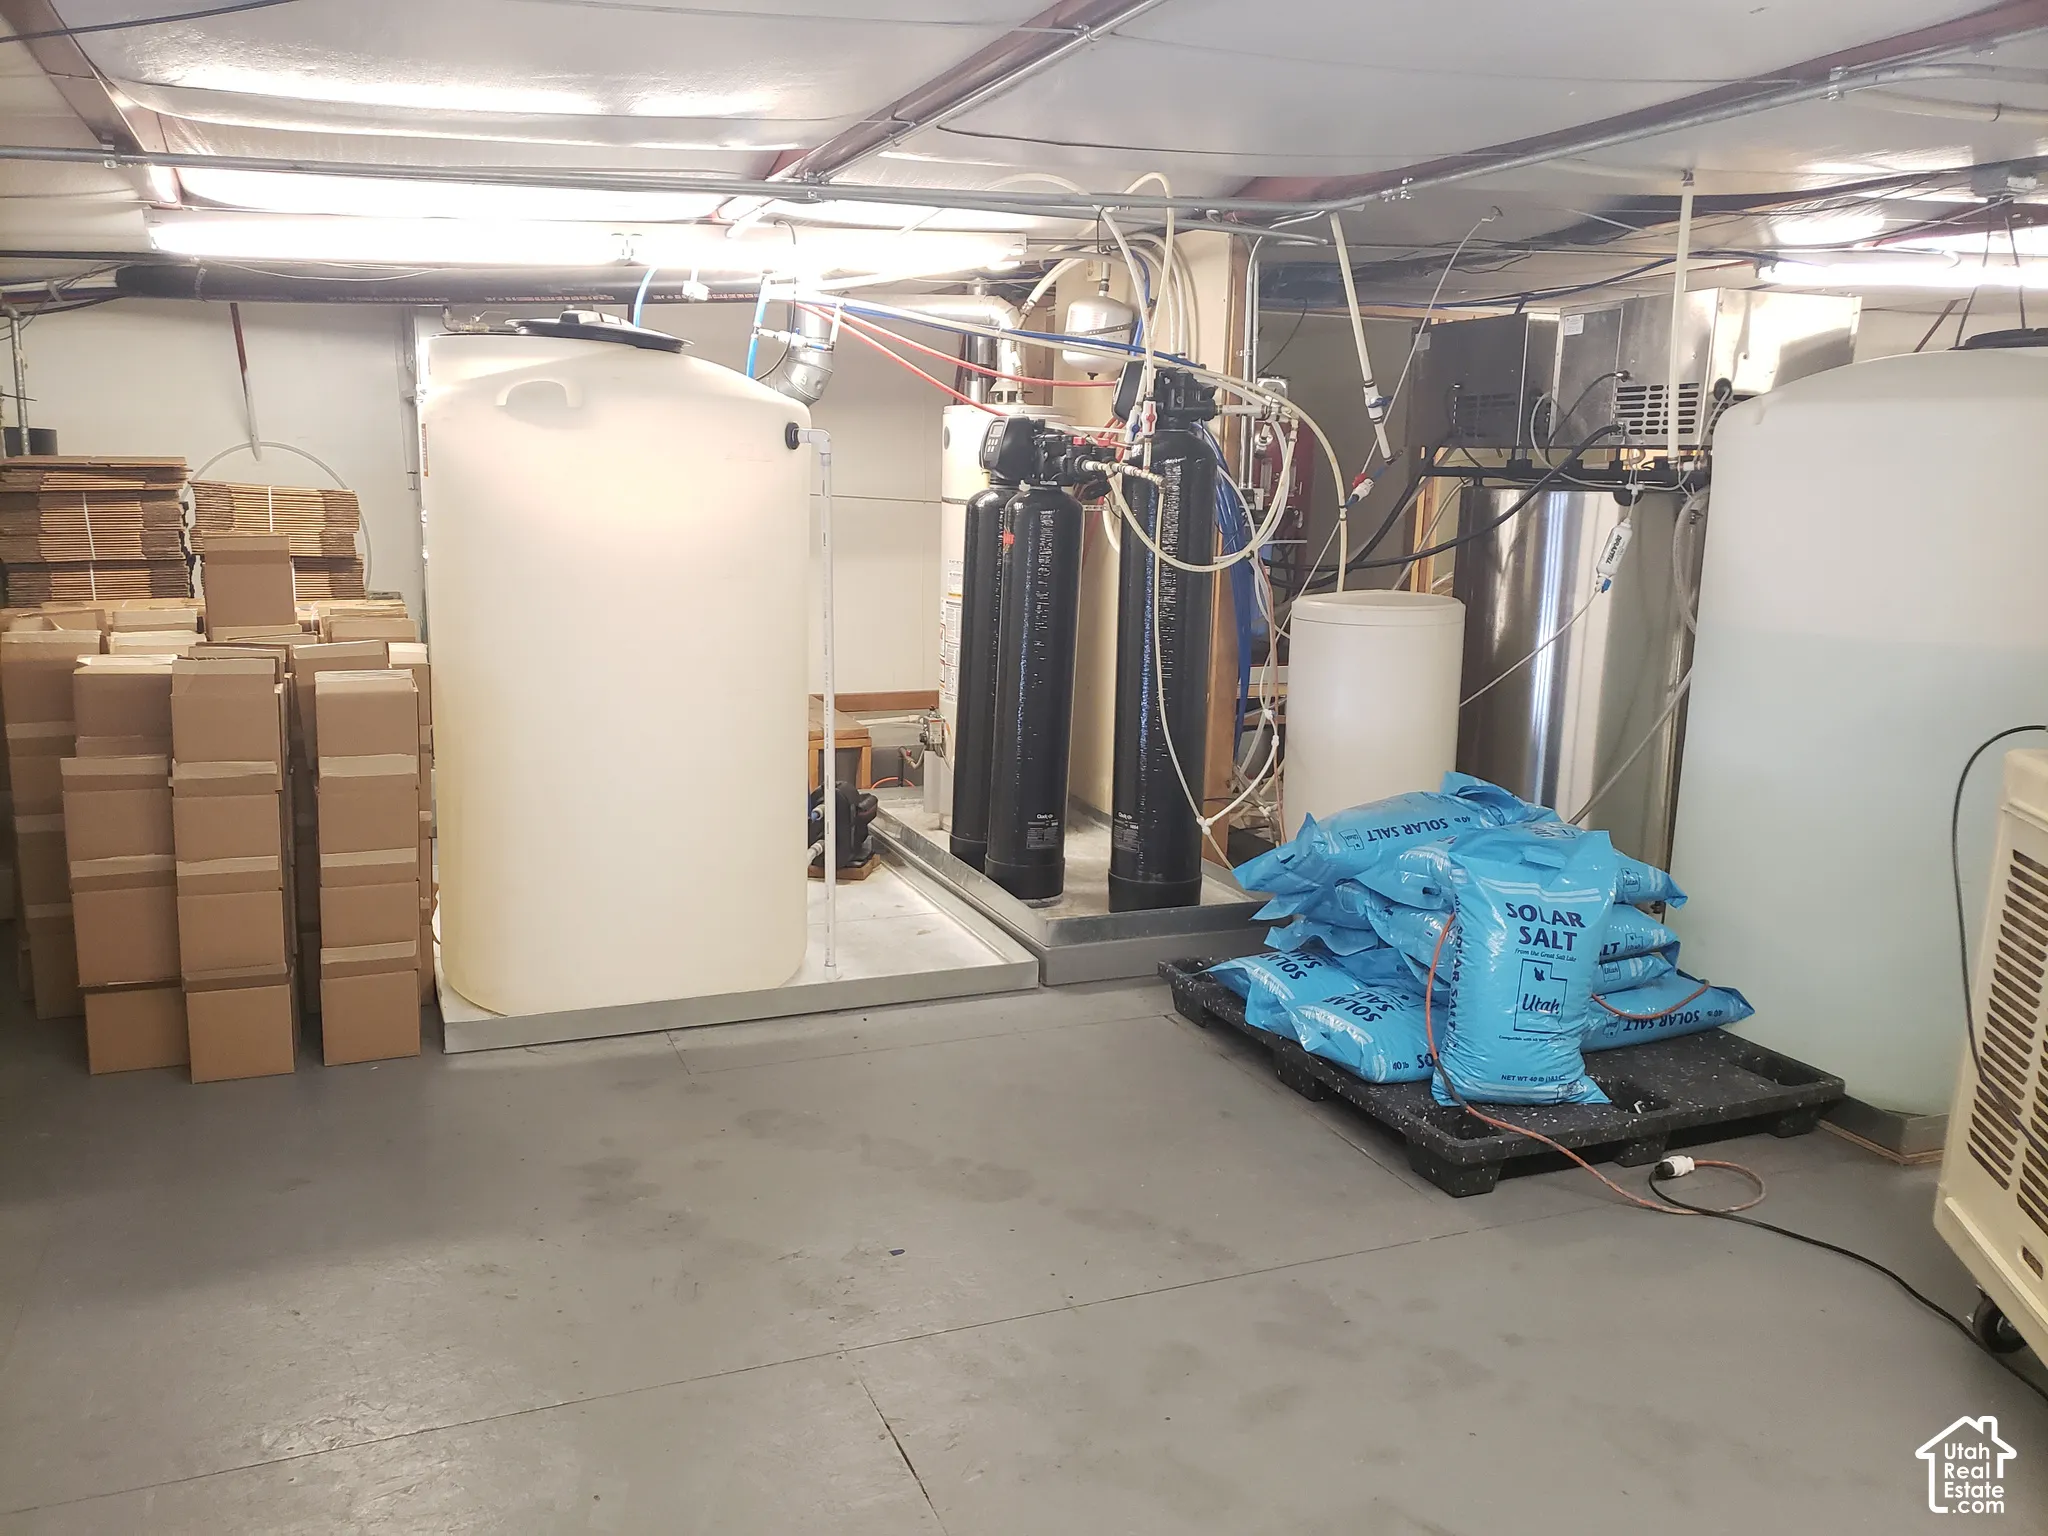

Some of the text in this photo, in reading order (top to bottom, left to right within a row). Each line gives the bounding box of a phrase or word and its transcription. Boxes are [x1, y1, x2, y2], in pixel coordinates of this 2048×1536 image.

[1367, 826, 1400, 842] SALT
[1401, 817, 1449, 835] SOLAR
[1505, 902, 1586, 928] SOLAR
[1518, 926, 1578, 952] SALT
[1531, 949, 1540, 957] the
[1540, 950, 1555, 959] Great
[1556, 953, 1566, 961] Salt
[1566, 954, 1577, 963] Lake
[1600, 942, 1620, 956] LT
[1291, 952, 1323, 969] SAL
[1322, 996, 1383, 1022] SOLAR
[1346, 991, 1396, 1012] SALT
[1522, 993, 1560, 1015] Utah
[1623, 1018, 1654, 1032] SALT
[1659, 1010, 1700, 1028] SOLAR
[1392, 1061, 1402, 1071] 40
